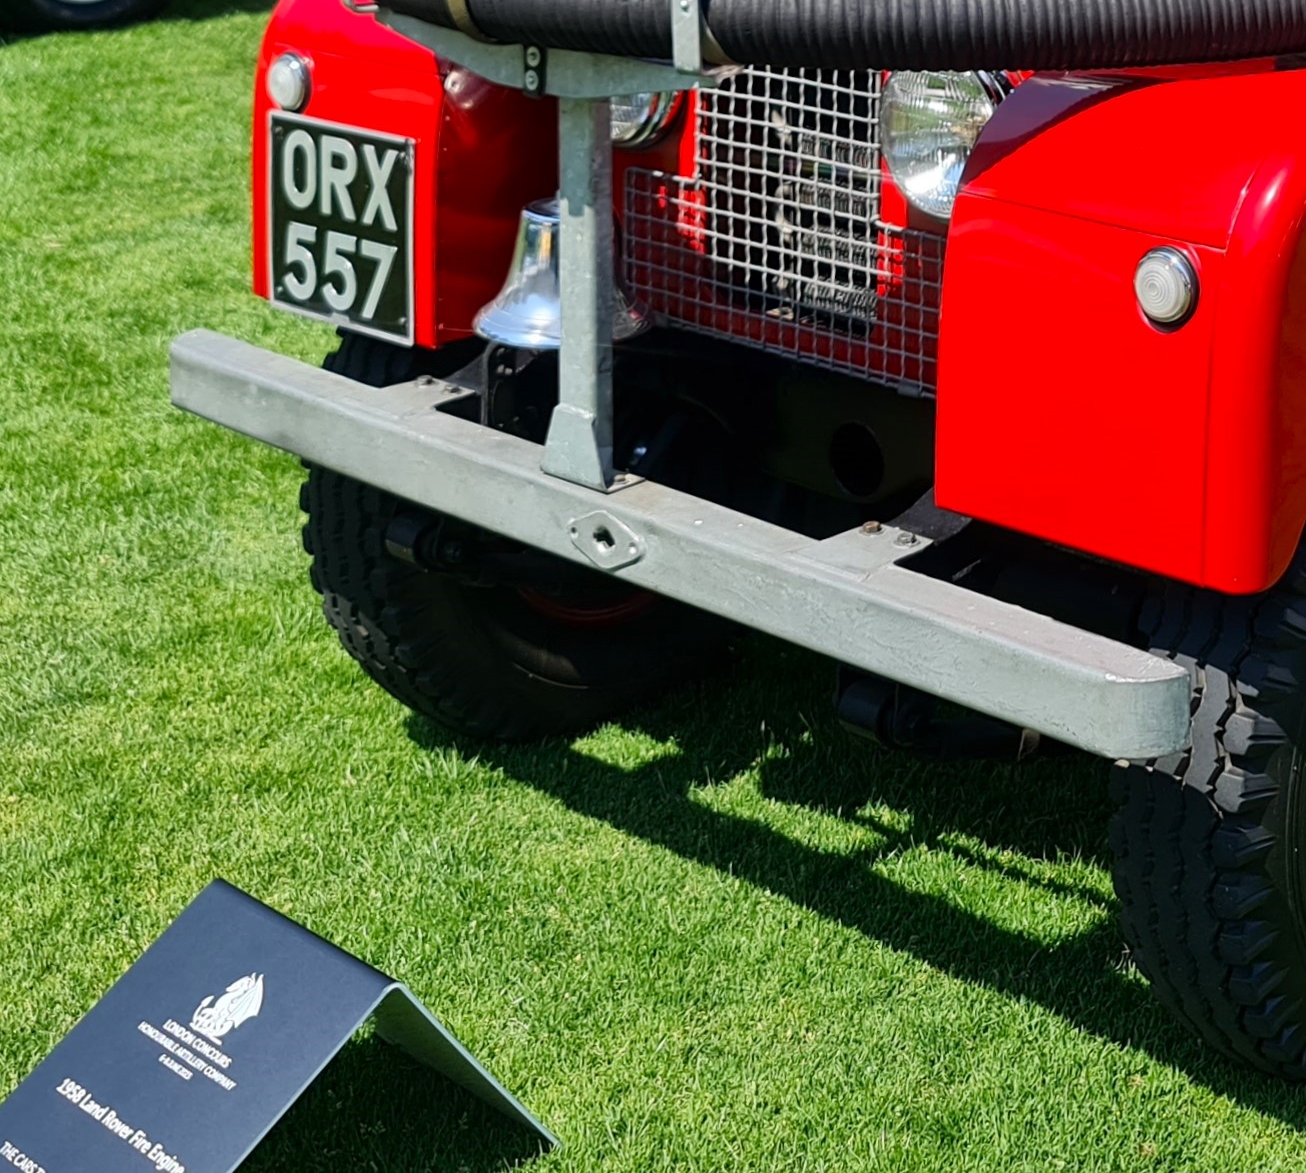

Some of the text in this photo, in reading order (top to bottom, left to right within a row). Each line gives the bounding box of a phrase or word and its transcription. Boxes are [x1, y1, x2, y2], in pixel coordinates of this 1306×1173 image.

[283, 129, 399, 232] ORX
[282, 221, 398, 320] 557
[162, 1019, 233, 1068] LONDON CONCOURS
[174, 1046, 208, 1071] ARTILLERY
[203, 1066, 237, 1091] COMPANY
[0, 1140, 20, 1161] THE
[56, 1078, 185, 1173] 1958 Land Rover Fire Engine
